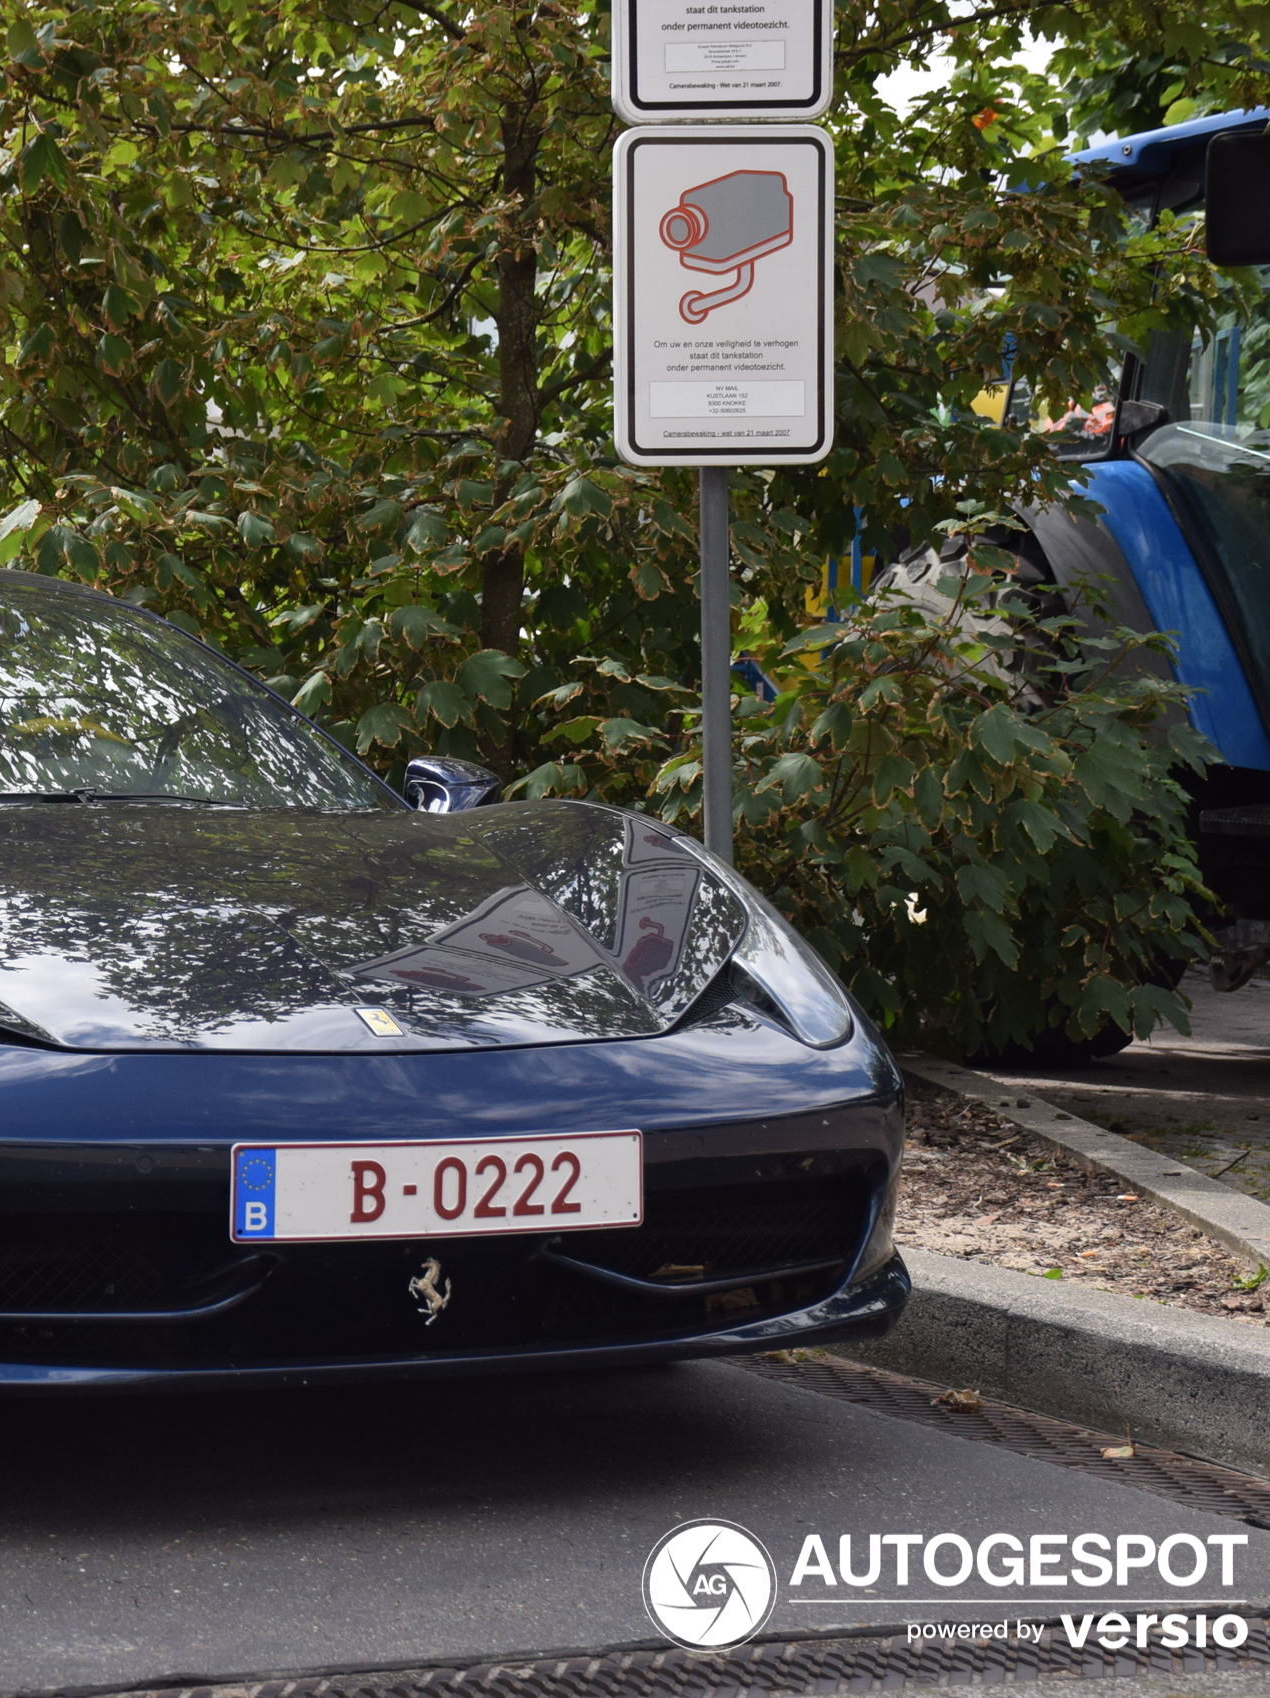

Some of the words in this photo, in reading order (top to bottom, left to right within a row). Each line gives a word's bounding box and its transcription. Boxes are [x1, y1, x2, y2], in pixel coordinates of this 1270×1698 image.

[686, 6, 706, 14] staat
[707, 6, 719, 14] dit
[720, 5, 765, 14] tankstation
[661, 22, 686, 31] onder
[687, 22, 732, 32] permanent
[733, 20, 790, 30] videotoezicht.
[668, 82, 716, 90] Camerabewaking
[653, 340, 668, 348] Om
[715, 340, 752, 349] veiligheid
[753, 340, 761, 348] te
[762, 340, 799, 349] verhogen
[689, 352, 709, 360] staat
[721, 351, 764, 359] tankstation
[690, 364, 732, 373] permanent
[733, 363, 786, 371] videotoezicht.
[245, 1202, 267, 1231] B
